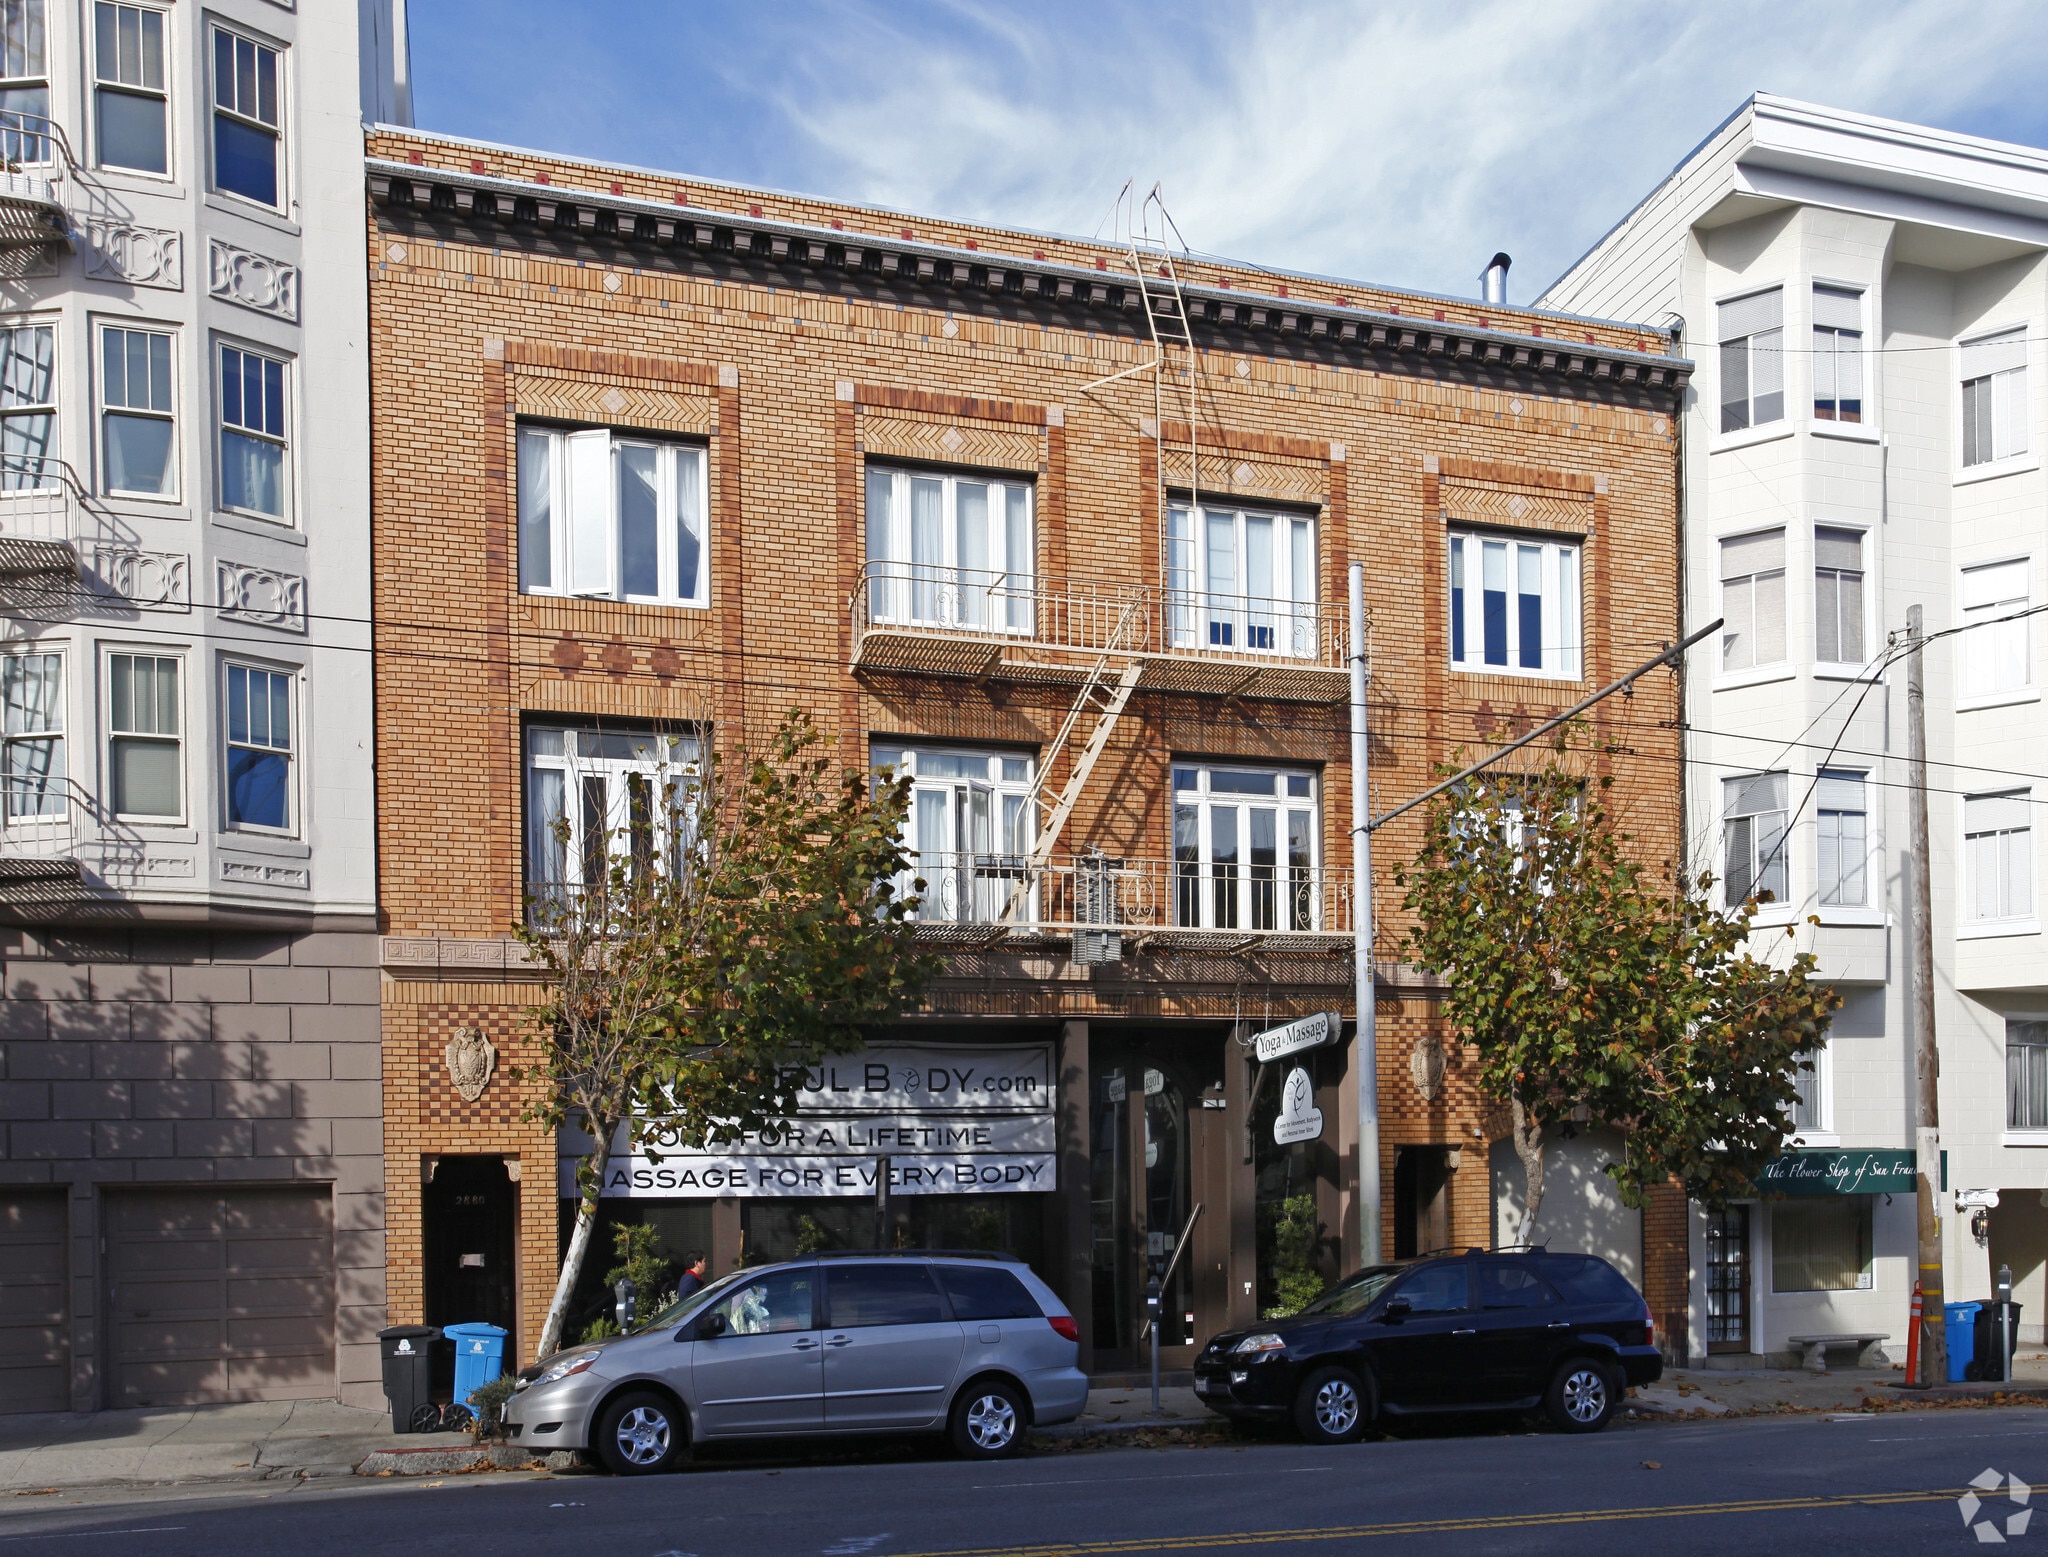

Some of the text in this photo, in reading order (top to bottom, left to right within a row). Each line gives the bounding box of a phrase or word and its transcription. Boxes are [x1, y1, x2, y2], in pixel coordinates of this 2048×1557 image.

[1260, 1035, 1281, 1056] Yoga
[1286, 1019, 1326, 1045] Massage
[635, 1123, 992, 1147] YOA FOR A LIFETIME
[759, 1168, 825, 1189] FOR
[836, 1164, 945, 1187] EVERY
[954, 1163, 1045, 1185] BODY
[1765, 1154, 1917, 1192] The Flower Shop of San Franc
